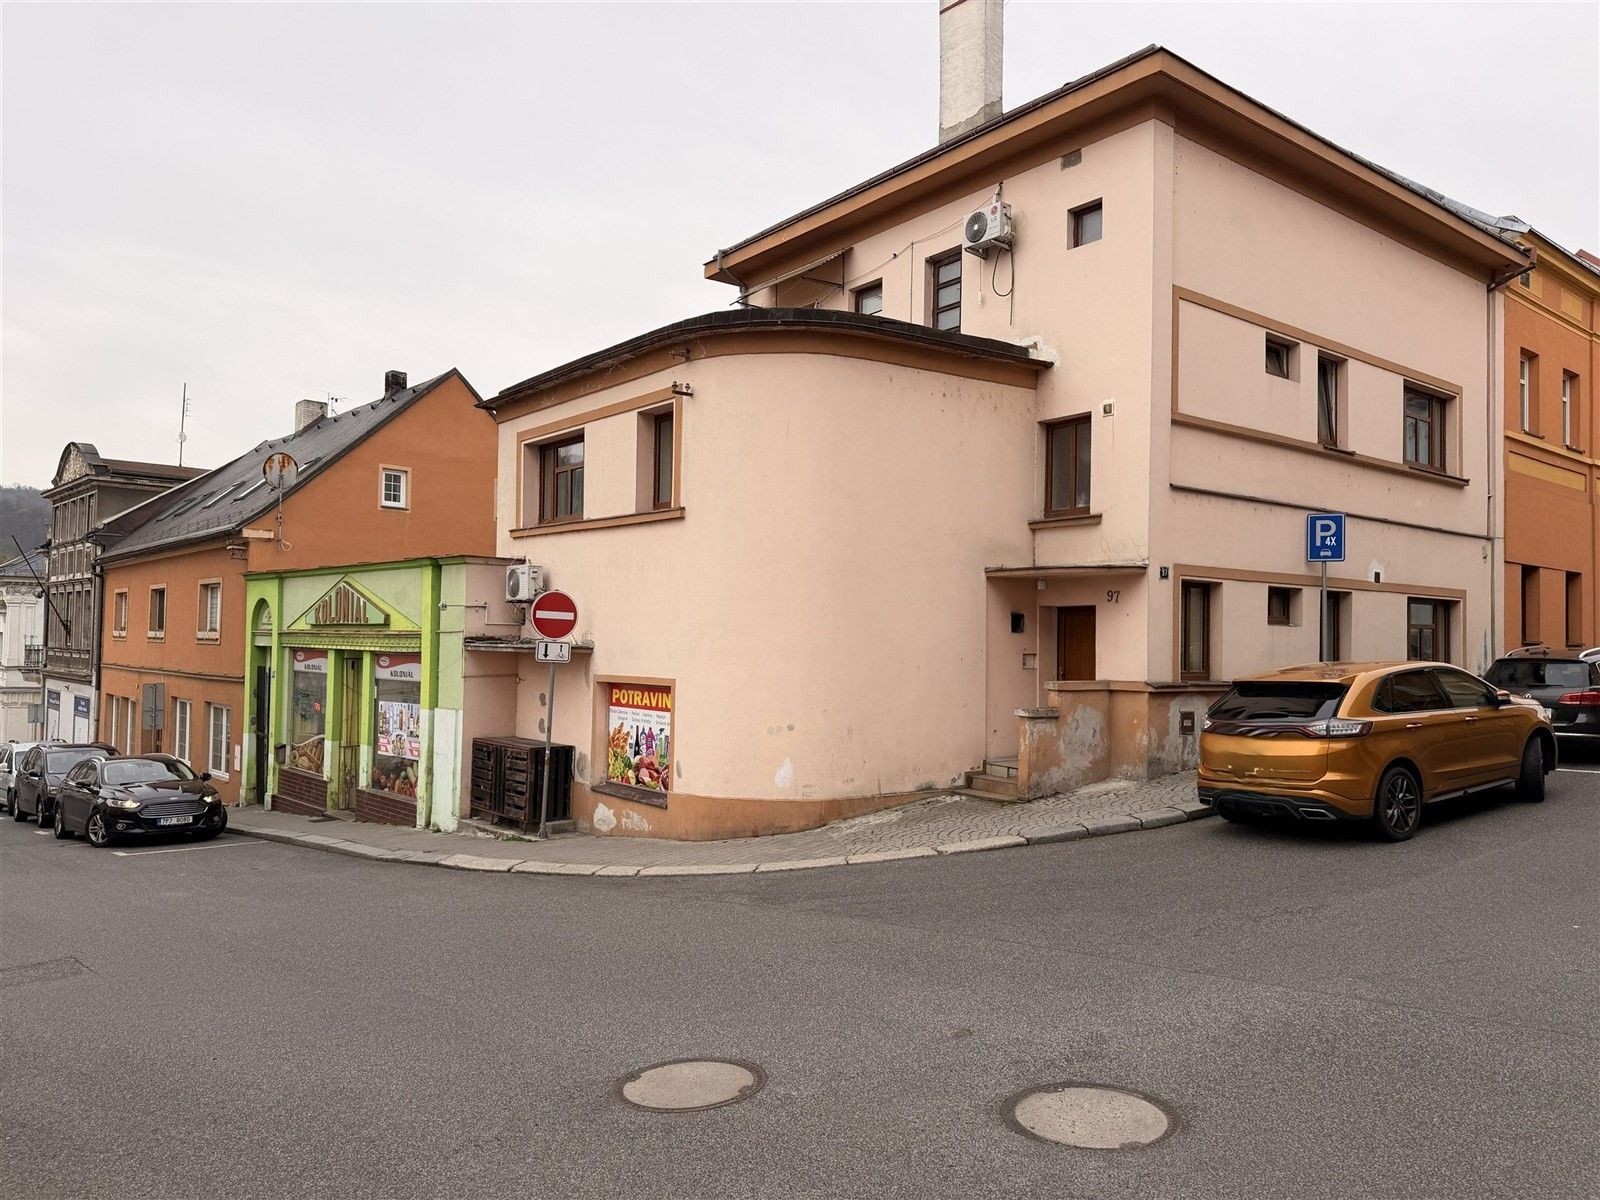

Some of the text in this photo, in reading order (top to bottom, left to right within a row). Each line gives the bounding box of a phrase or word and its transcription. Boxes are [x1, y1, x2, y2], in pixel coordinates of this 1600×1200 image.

[1315, 519, 1336, 546] P
[1107, 590, 1121, 603] 97
[612, 688, 672, 708] POTRAVIN
